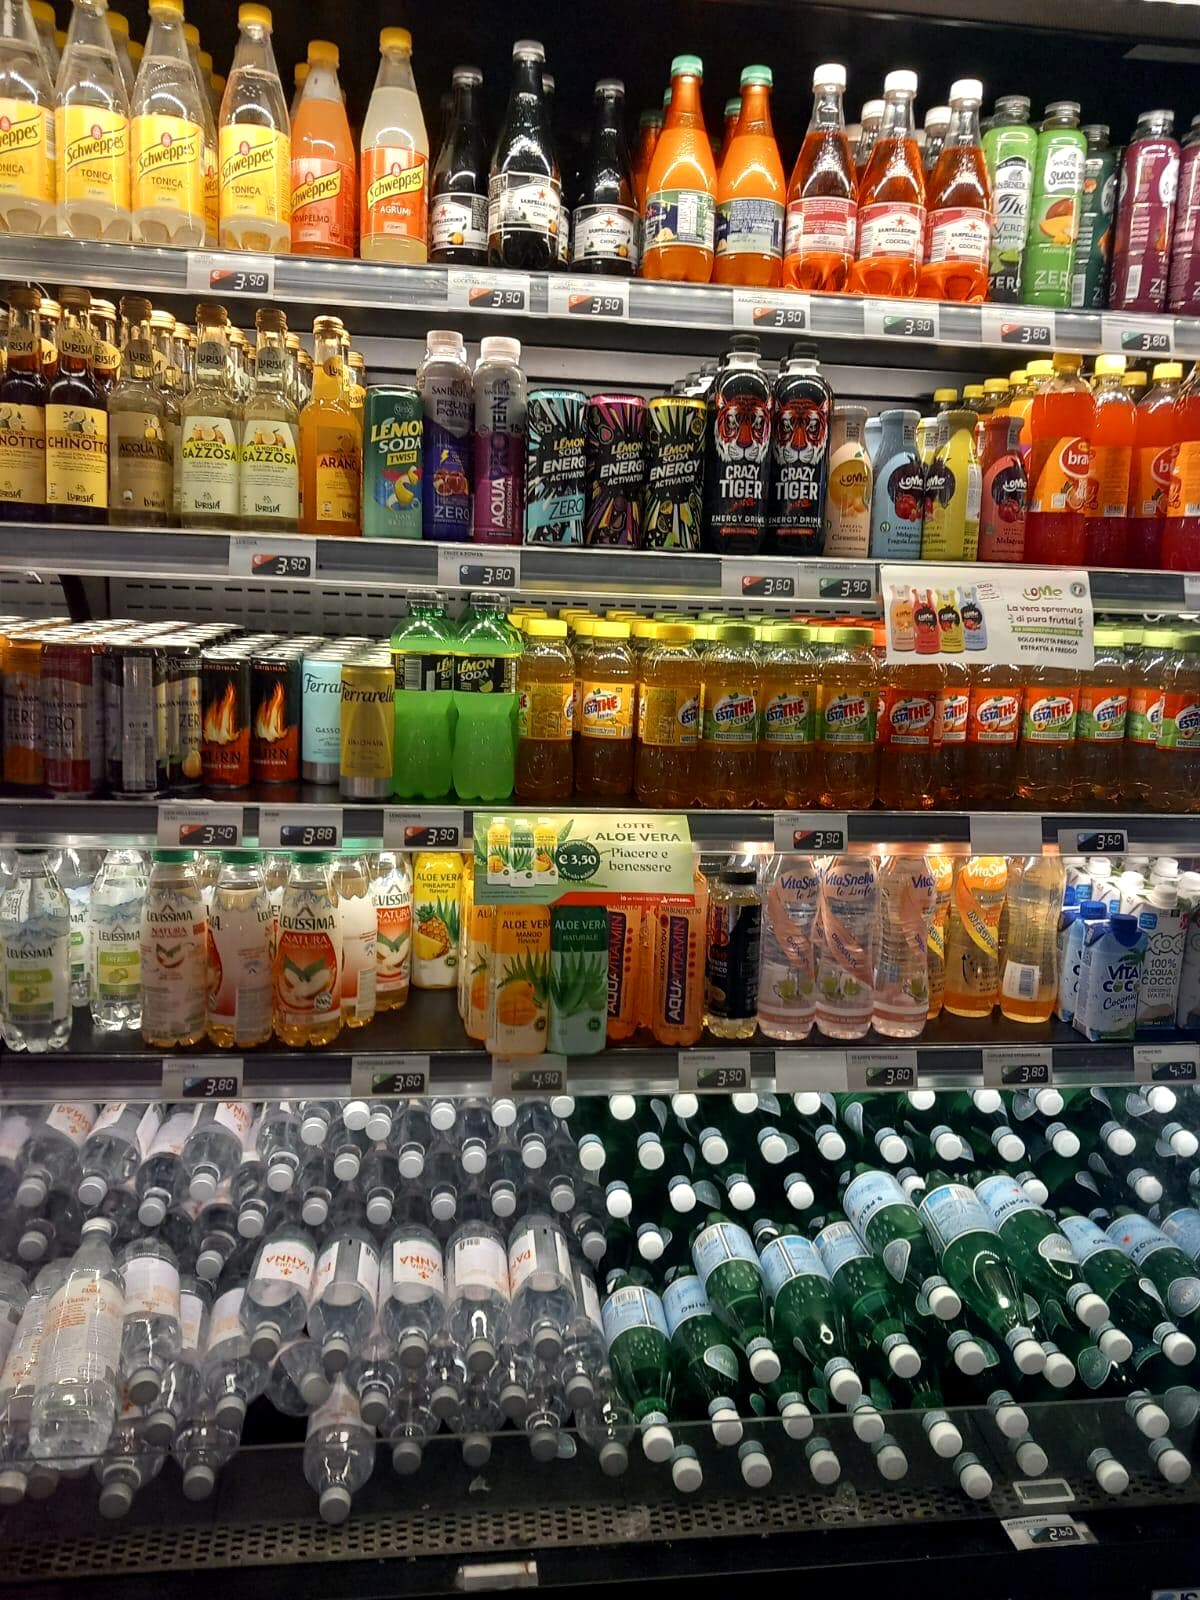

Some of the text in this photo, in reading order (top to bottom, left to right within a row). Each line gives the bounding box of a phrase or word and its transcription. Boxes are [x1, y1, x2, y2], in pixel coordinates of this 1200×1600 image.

[67, 135, 125, 165] Schweppes
[138, 142, 195, 174] Schweppes
[221, 148, 275, 180] Schweppes
[81, 168, 114, 182] TONICA
[151, 176, 183, 189] TONICA
[370, 171, 422, 203] Schweppes
[231, 185, 261, 196] TONICA
[380, 205, 411, 216] AGRUMI
[294, 213, 330, 224] OMPELMO
[491, 291, 520, 307] 3.90
[591, 298, 620, 314] 3.90
[774, 310, 802, 327] 3.90
[904, 320, 931, 335] 3.90
[1022, 327, 1047, 343] 3.80
[1142, 334, 1167, 350] 3.80
[62, 342, 93, 353] LURISIA
[379, 437, 422, 454] SODA
[553, 436, 585, 451] LEMON
[611, 441, 643, 455] LEMON
[658, 443, 694, 458] LEMON
[182, 447, 237, 462] GAZZOSA
[242, 451, 297, 465] GAZZOSA
[390, 452, 415, 464] TWIST
[558, 447, 582, 458] SODA
[615, 451, 640, 462] SODA
[662, 453, 689, 464] SODA
[650, 459, 700, 481] ENERGY
[725, 464, 759, 481] CRAZY
[780, 466, 816, 483] CRAZY
[655, 474, 695, 489] ACTIVATOR
[720, 479, 762, 499] TIGER
[775, 482, 818, 500] TIGER
[67, 492, 95, 503] LURISIA
[491, 477, 507, 528] AQUA
[195, 500, 221, 511] LURISIA
[255, 503, 281, 513] LURISIA
[434, 504, 470, 520] ZERO
[550, 498, 584, 520] ZERO
[712, 515, 743, 523] ENERGY
[482, 568, 511, 585] 3.80
[764, 578, 791, 595] 3.60
[841, 580, 868, 596] 3.90
[1007, 604, 1018, 612] La
[1041, 606, 1083, 615] spremuta
[1016, 615, 1025, 623] di
[1026, 616, 1047, 624] pura
[1035, 637, 1056, 645] FRUTTA
[1020, 645, 1049, 653] ESTRATTA
[1055, 647, 1078, 655] FREDDO
[457, 658, 495, 674] LEMON
[460, 669, 489, 680] SODA
[616, 822, 655, 830] LOTTE
[203, 826, 233, 844] 3.40
[427, 829, 454, 845] 3.90
[595, 832, 681, 843] ALOE VERA
[814, 832, 840, 848] 3.90
[1097, 833, 1121, 849] 3.60
[570, 854, 597, 866] 3,50
[611, 848, 669, 859] Piacere e
[609, 861, 672, 873] benessere
[416, 872, 463, 882] ALOE VERA
[825, 873, 874, 887] VitaSnella
[147, 911, 193, 922] LEVISSIMA
[280, 915, 335, 930] LEVISSIMA
[502, 919, 527, 930] ALOE
[555, 919, 606, 930] ALOE VERA
[99, 930, 140, 942] LEVISSIMA
[152, 927, 187, 937] NATURA
[515, 930, 543, 938] MANGO
[562, 933, 599, 942] NATURALE
[284, 934, 330, 945] NATURA
[7, 947, 53, 960] LEVISSIMA
[1151, 959, 1177, 969] 100%
[1108, 964, 1139, 980] VITA
[1142, 969, 1173, 977] ACQUA
[532, 1071, 560, 1088] 4.90
[1021, 1067, 1046, 1084] 3.80
[205, 1078, 234, 1096] 3.80
